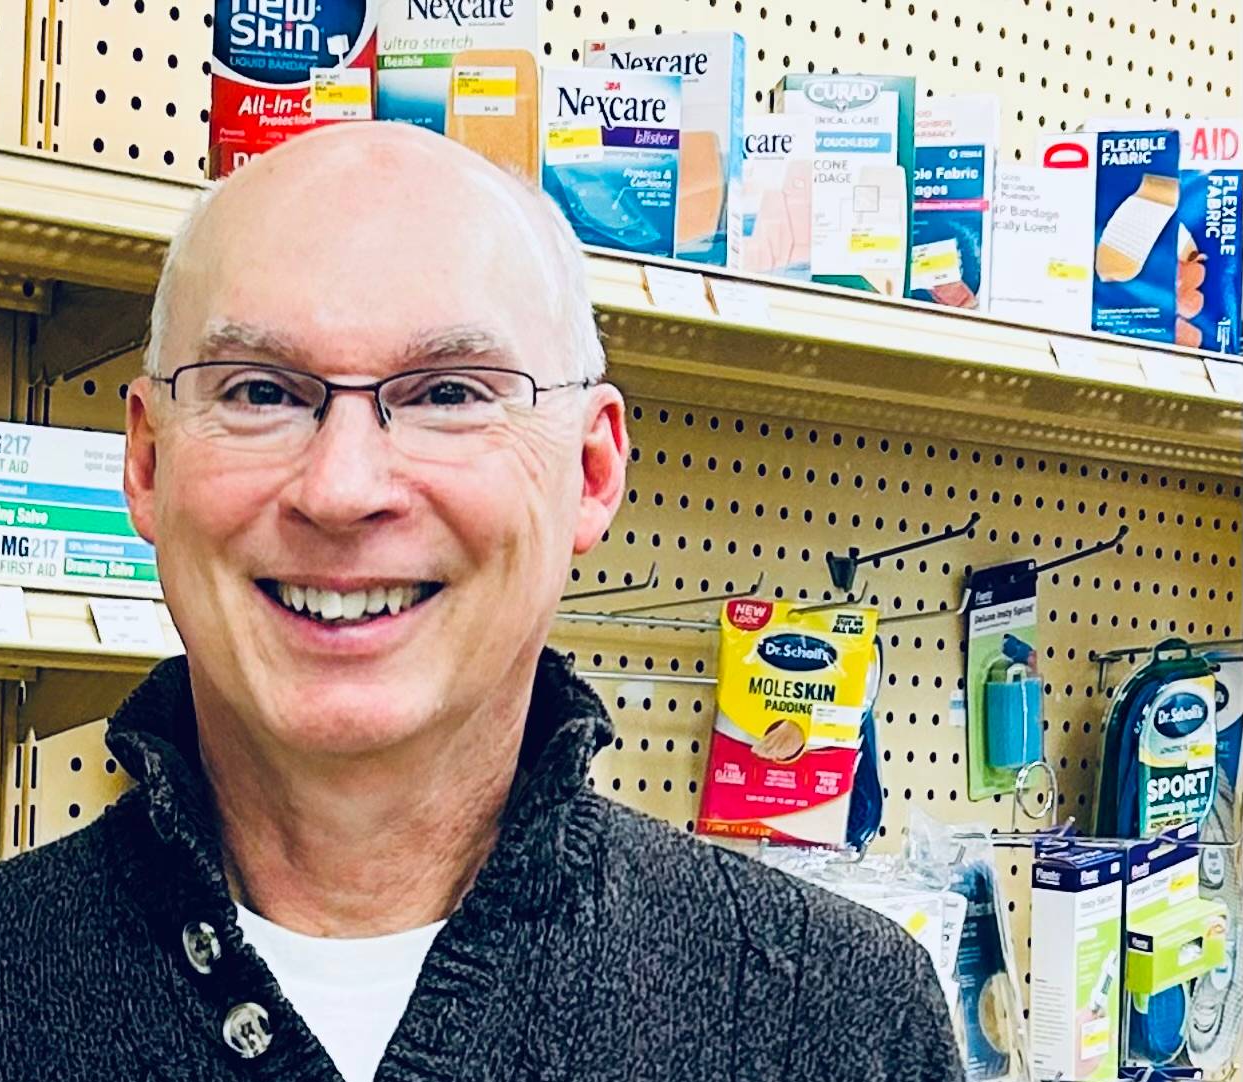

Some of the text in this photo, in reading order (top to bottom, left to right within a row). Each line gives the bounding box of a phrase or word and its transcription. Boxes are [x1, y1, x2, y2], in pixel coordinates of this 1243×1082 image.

[408, 0, 514, 27] Nexcare
[230, 14, 320, 52] Skin
[384, 36, 473, 51] ultra stretch
[384, 55, 423, 68] flexible
[807, 81, 874, 103] CURAD
[558, 87, 667, 129] Nexcare
[635, 129, 675, 147] blister
[1102, 137, 1166, 152] FLEXIBLE
[1102, 151, 1152, 166] FABRIC
[1205, 175, 1224, 238] FABRIC
[1220, 175, 1239, 256] FLEXIBLE
[8, 458, 30, 474] AID
[17, 507, 49, 526] Salve
[1, 535, 60, 560] MG217
[0, 560, 58, 577] FIRST AID
[65, 557, 136, 578] Drawing Salve
[734, 603, 767, 618] NEW
[748, 677, 837, 703] MOLESKIN
[1146, 770, 1210, 804] SPORT
